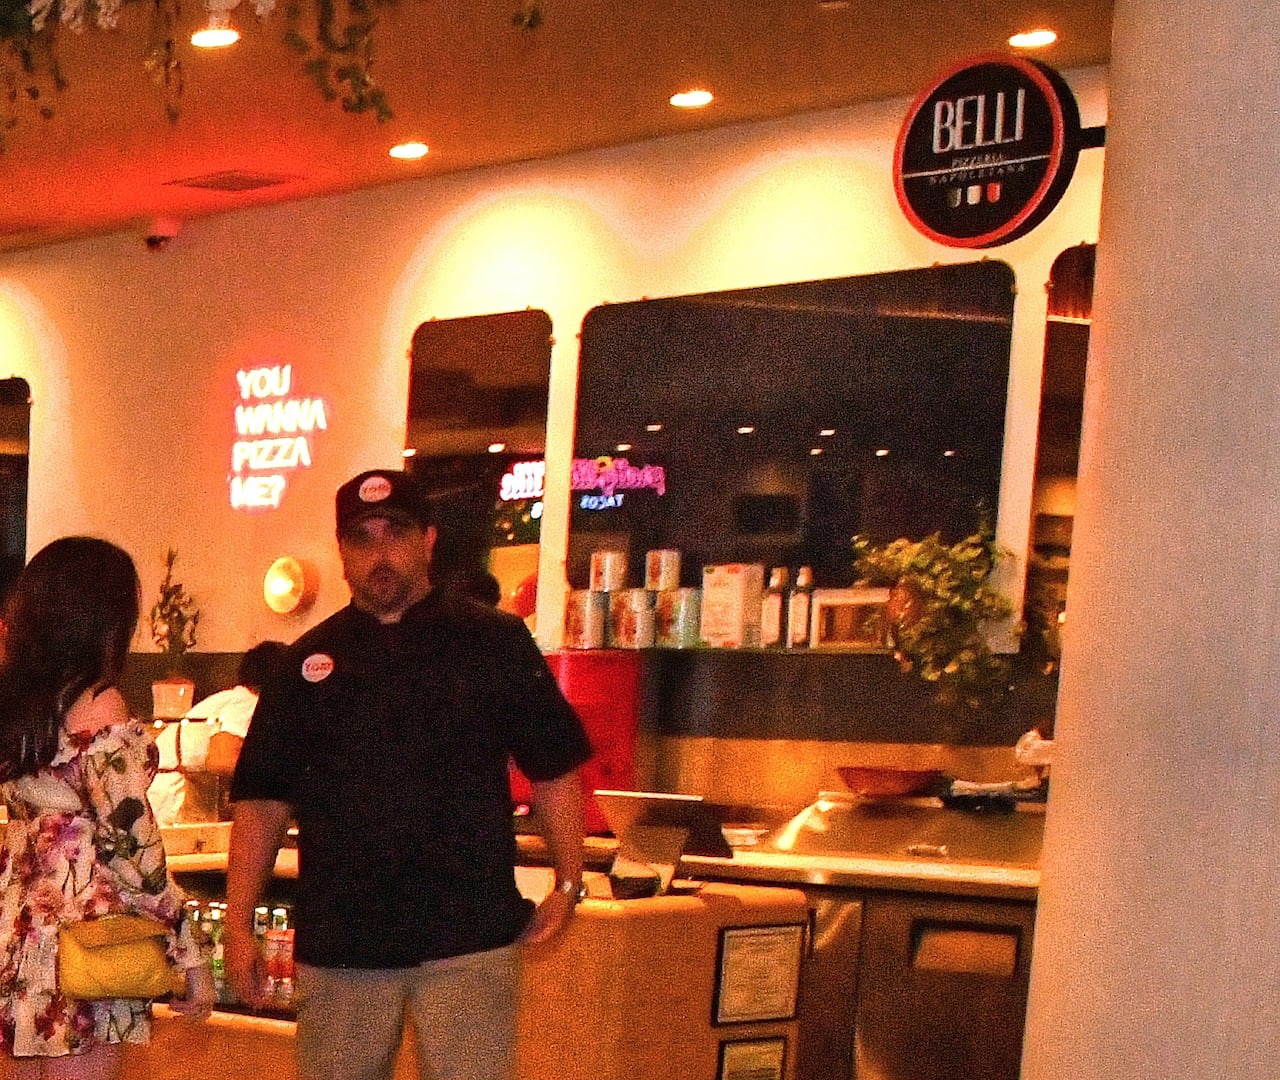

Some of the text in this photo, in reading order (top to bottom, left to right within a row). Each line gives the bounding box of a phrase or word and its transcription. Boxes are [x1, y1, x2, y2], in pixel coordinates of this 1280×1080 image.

[932, 88, 1026, 154] BELLI
[236, 364, 291, 399] YOU
[235, 398, 327, 435] WANNA
[232, 436, 312, 472] PIZZA
[230, 475, 286, 509] ME?
